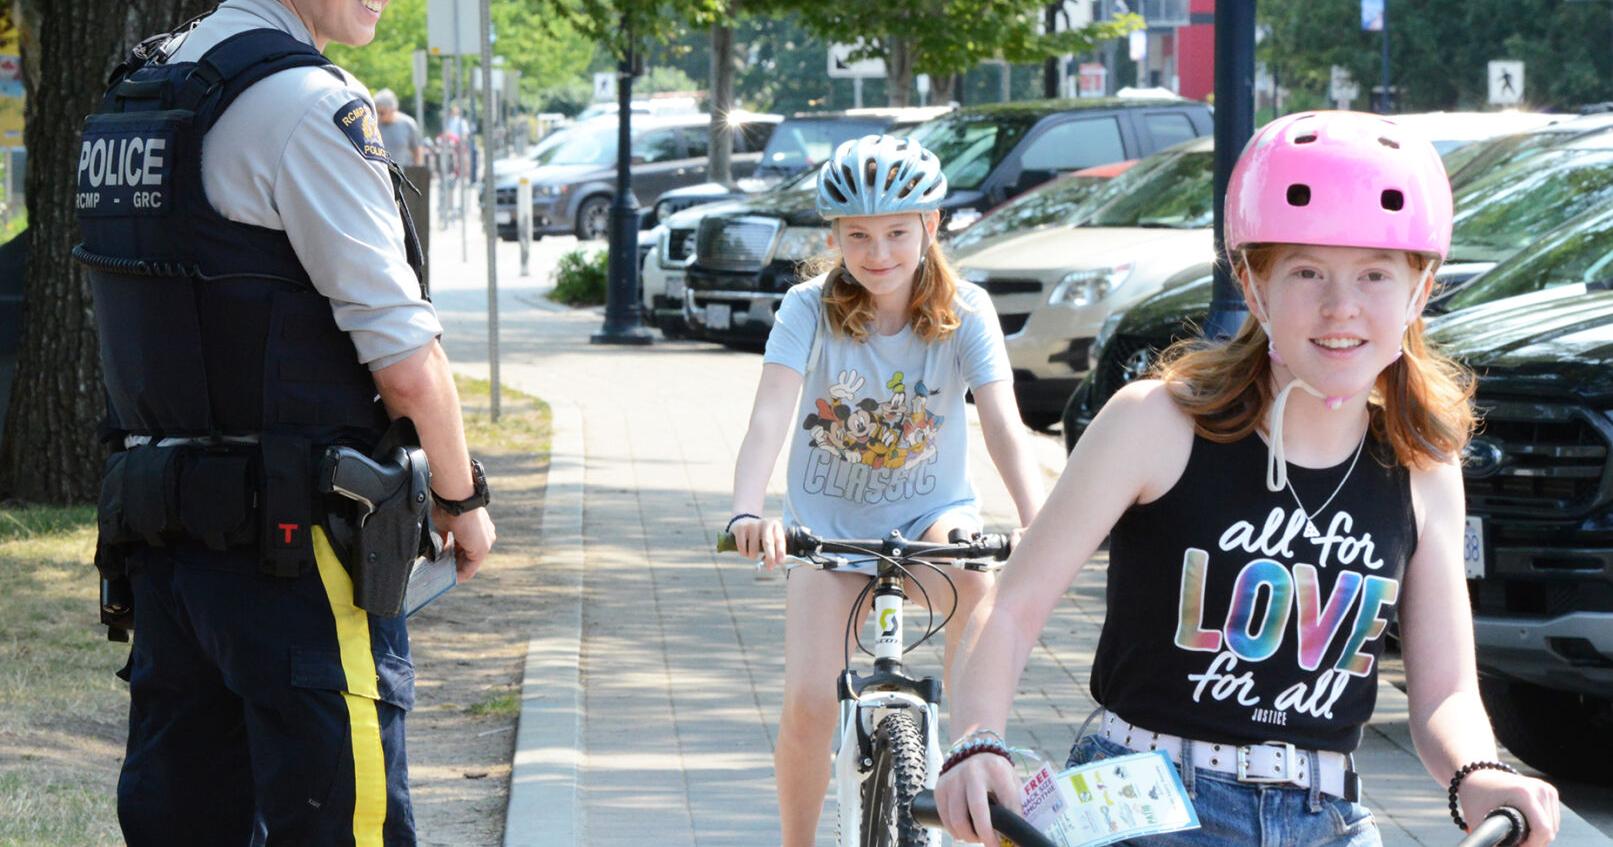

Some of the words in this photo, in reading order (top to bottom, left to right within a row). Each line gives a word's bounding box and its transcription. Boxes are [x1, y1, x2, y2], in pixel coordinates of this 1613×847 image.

[342, 107, 364, 127] RCMP
[78, 137, 166, 187] POLICE
[133, 192, 162, 208] GRC
[803, 447, 938, 504] CLASSIC
[278, 523, 299, 544] T
[1219, 507, 1306, 558] all
[1311, 511, 1384, 569] for
[1174, 547, 1399, 677] LOVE
[1188, 651, 1260, 706] for
[1274, 668, 1350, 719] all
[1251, 708, 1288, 726] JUSTICE
[1024, 768, 1049, 795] FREE
